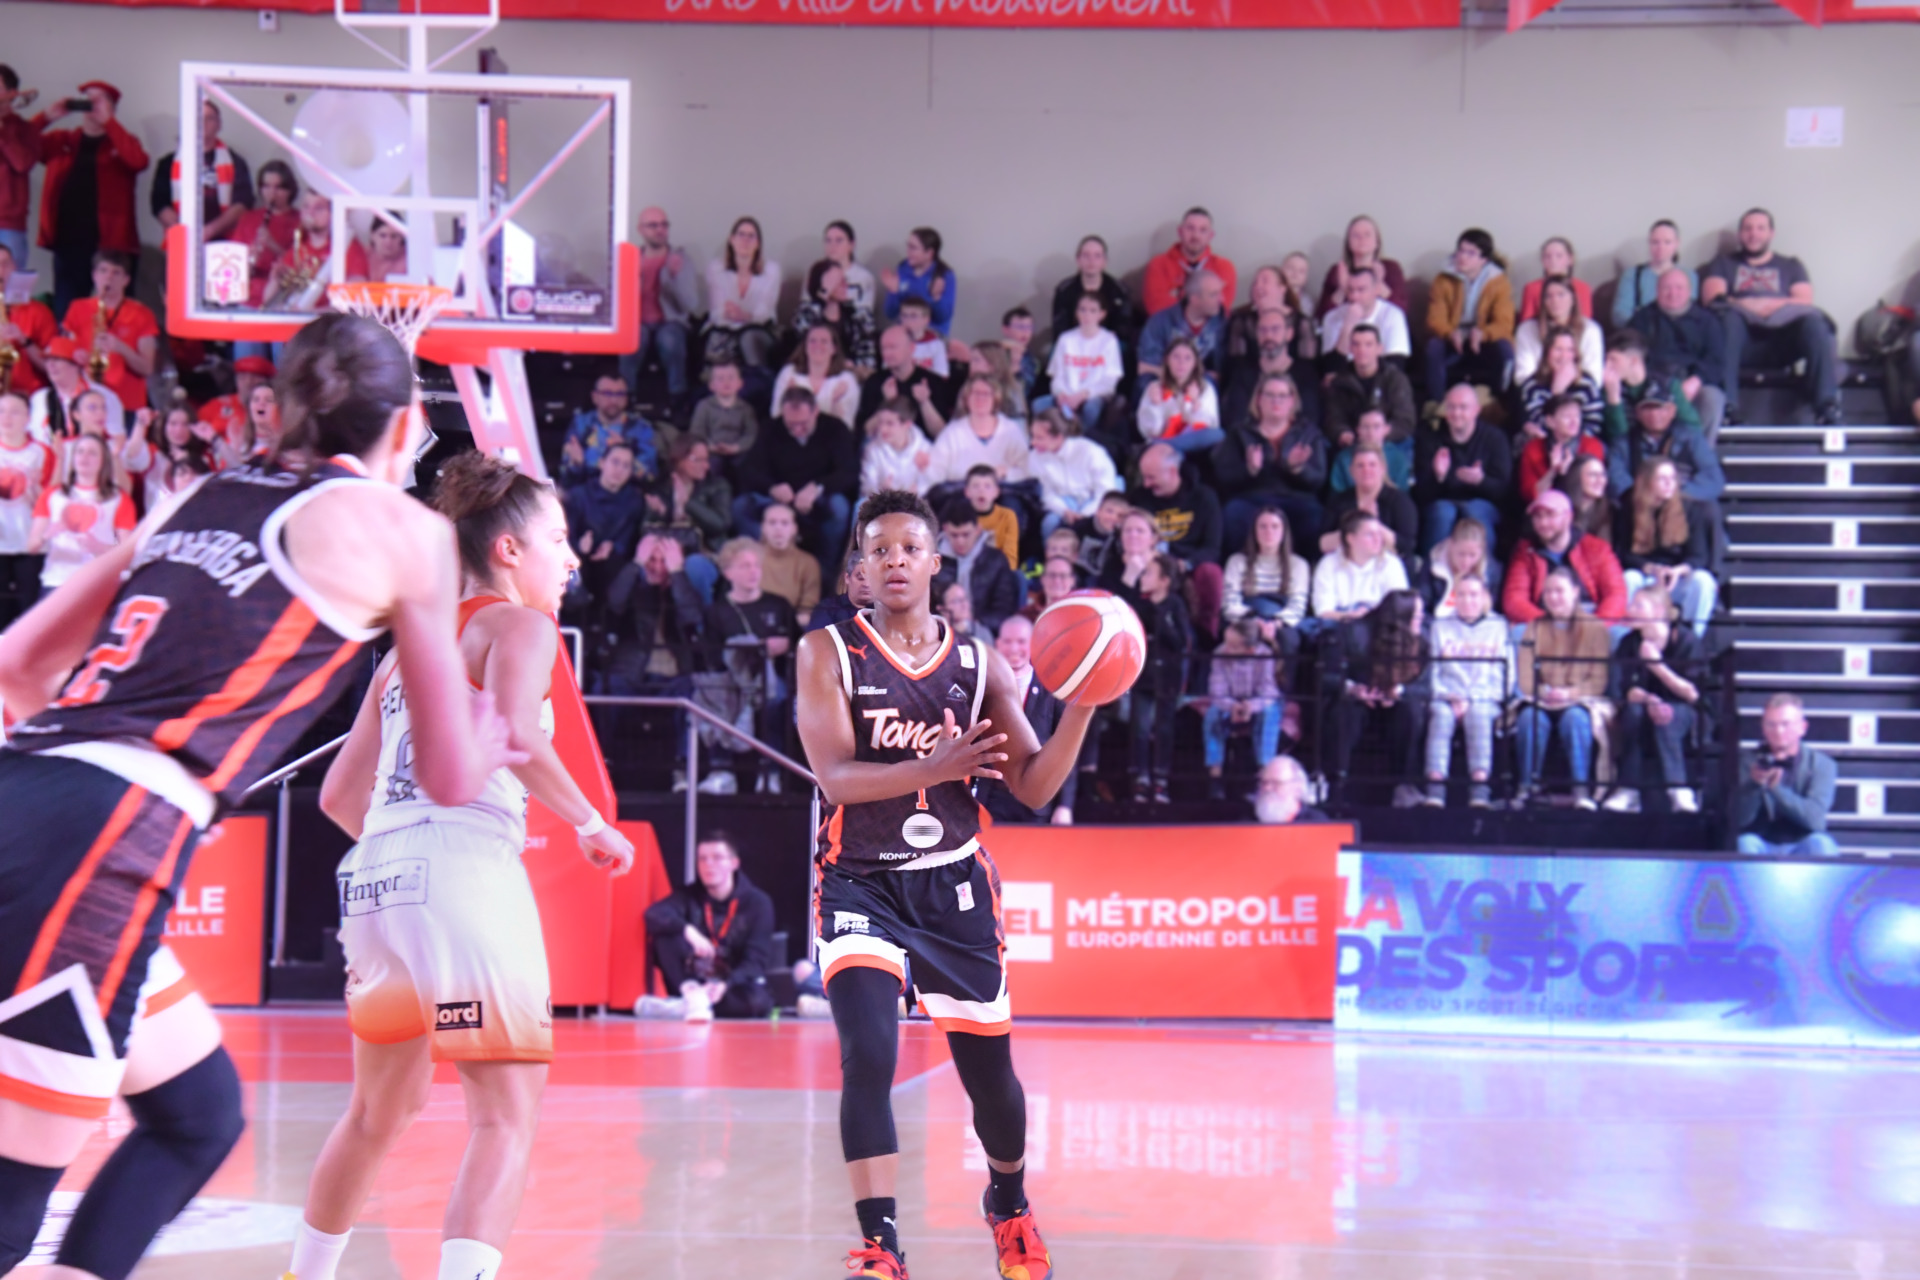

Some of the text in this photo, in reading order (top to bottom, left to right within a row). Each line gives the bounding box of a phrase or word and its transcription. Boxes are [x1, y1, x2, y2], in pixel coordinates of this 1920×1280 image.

[1066, 892, 1318, 927] MÉTROPOLE
[1066, 928, 1318, 949] EUROPÉENNE DE LILLE
[435, 1002, 478, 1024] ord
